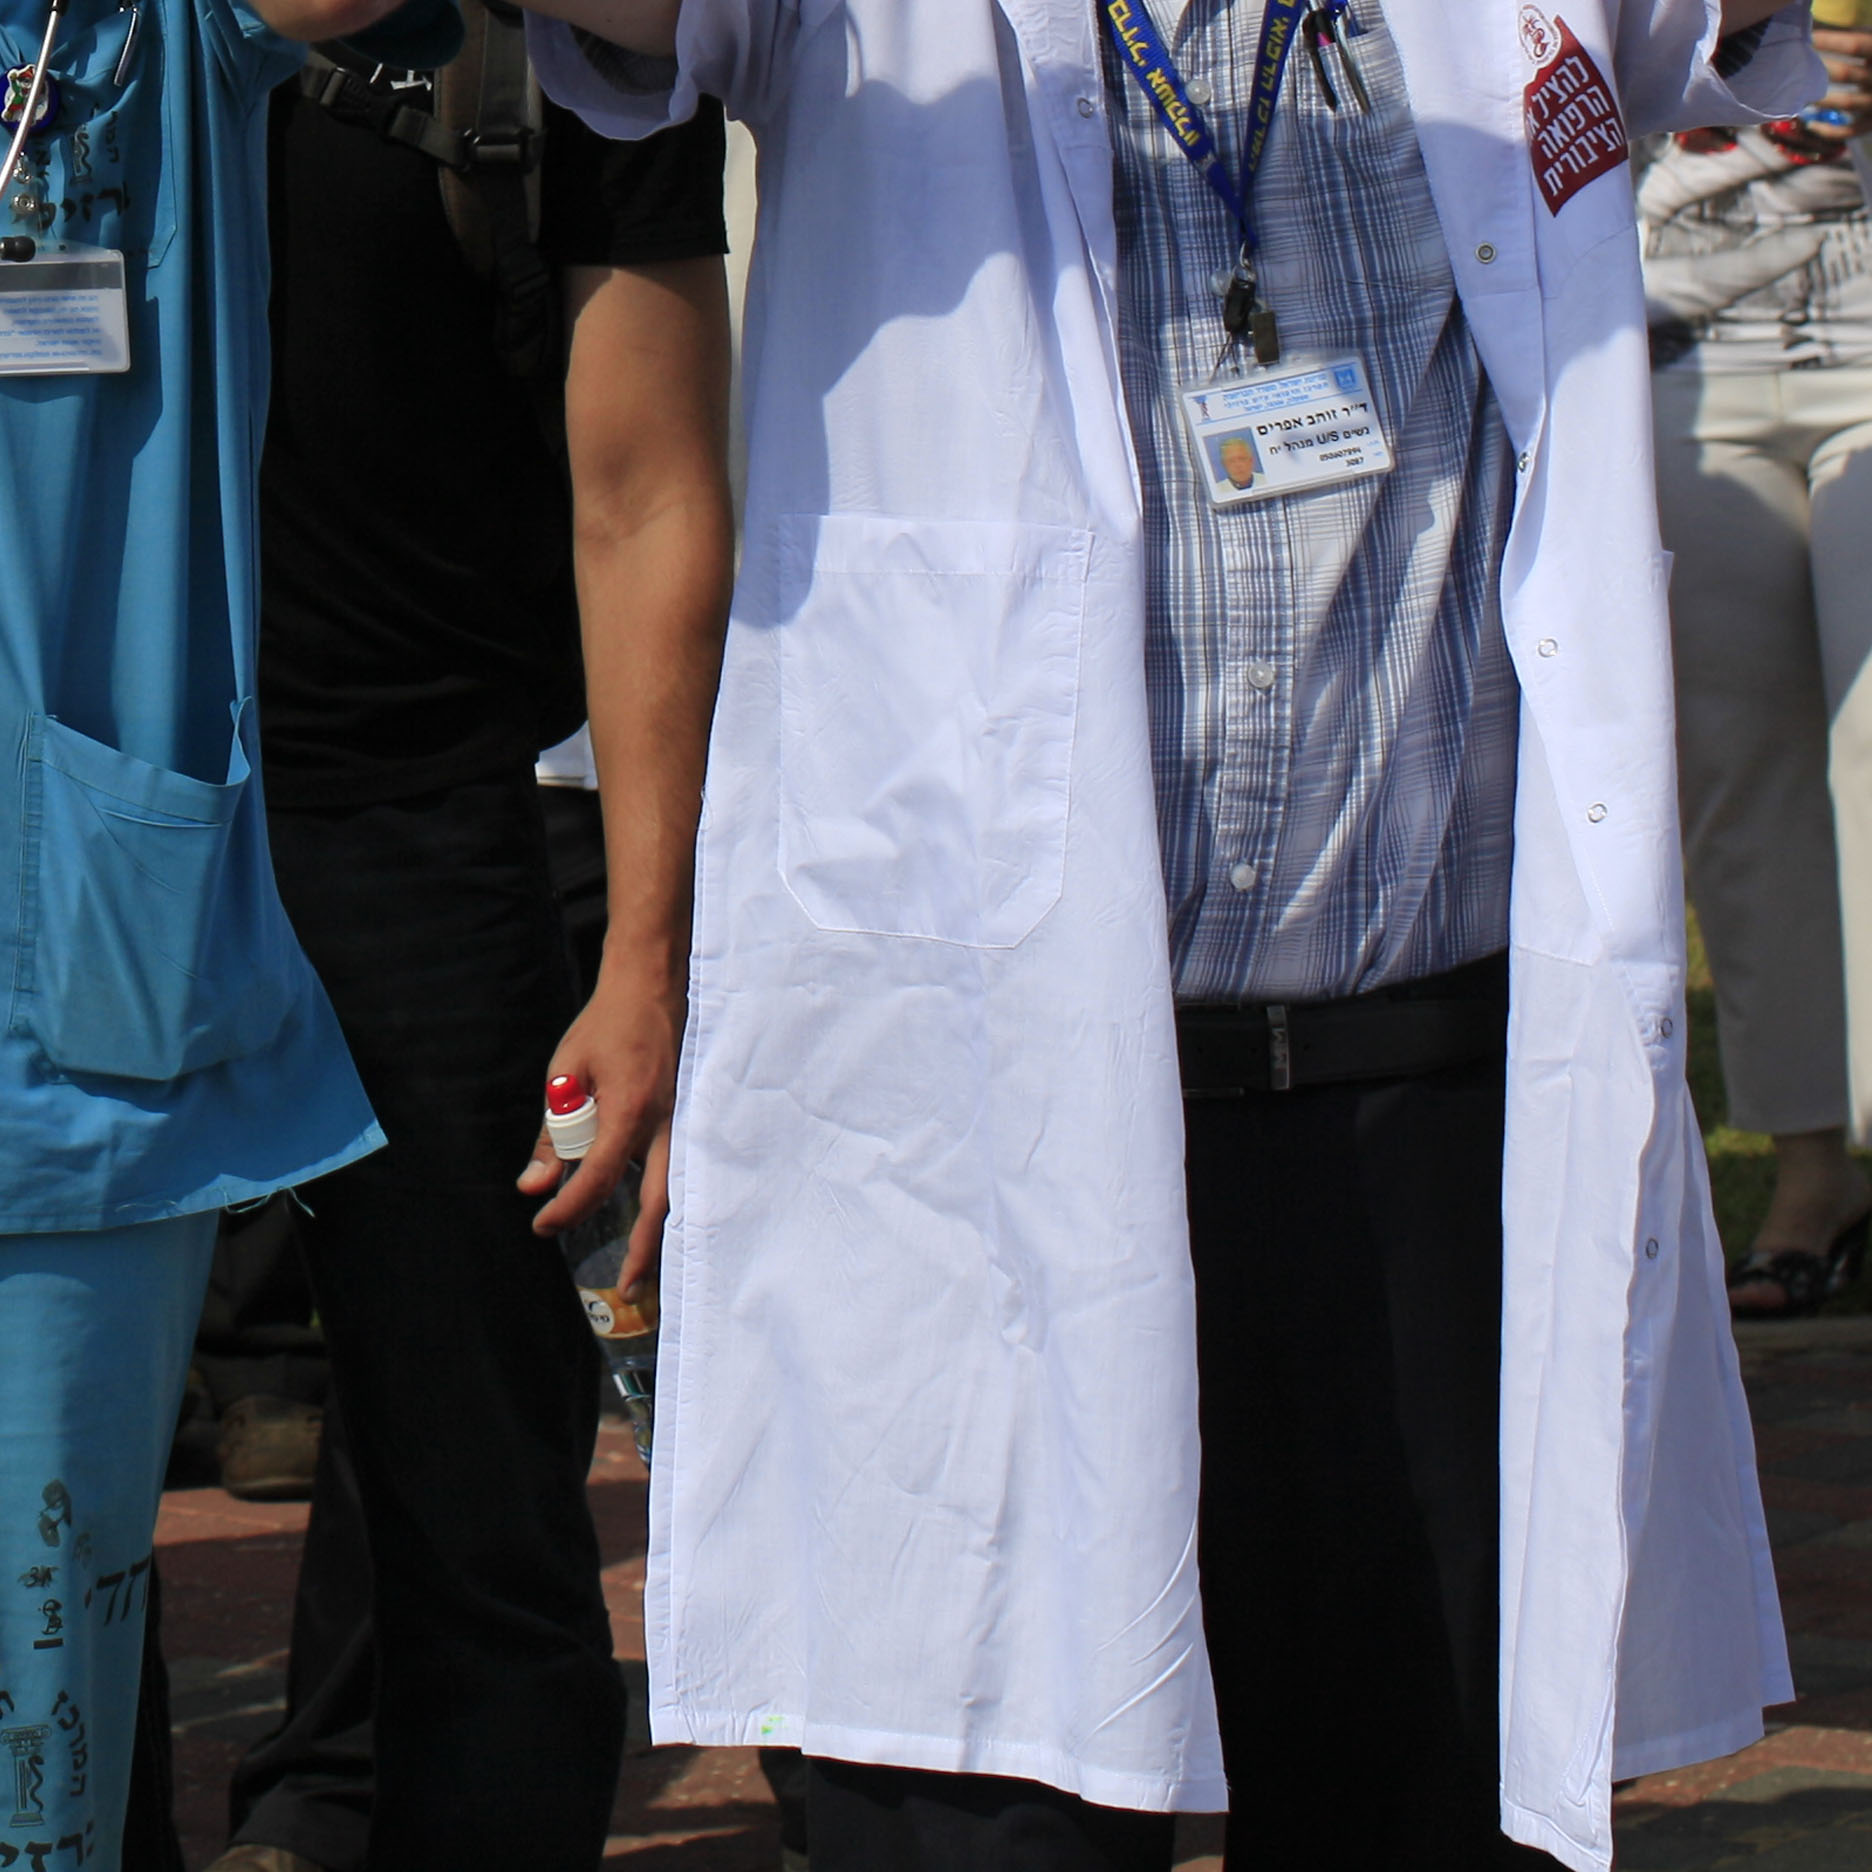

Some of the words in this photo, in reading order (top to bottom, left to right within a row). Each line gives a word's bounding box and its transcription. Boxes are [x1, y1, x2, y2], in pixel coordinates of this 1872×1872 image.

[1146, 67, 1201, 147] אשקלון
[1530, 54, 1591, 120] להציל
[1537, 84, 1611, 160] הרפואה
[1542, 117, 1626, 197] הציבורית
[1257, 416, 1304, 437] אפרים
[1308, 408, 1339, 427] זוהב
[1316, 430, 1341, 446] U/S
[1343, 425, 1371, 441] נשים
[1283, 435, 1315, 455] מנהל
[51, 1690, 88, 1798] המרכז
